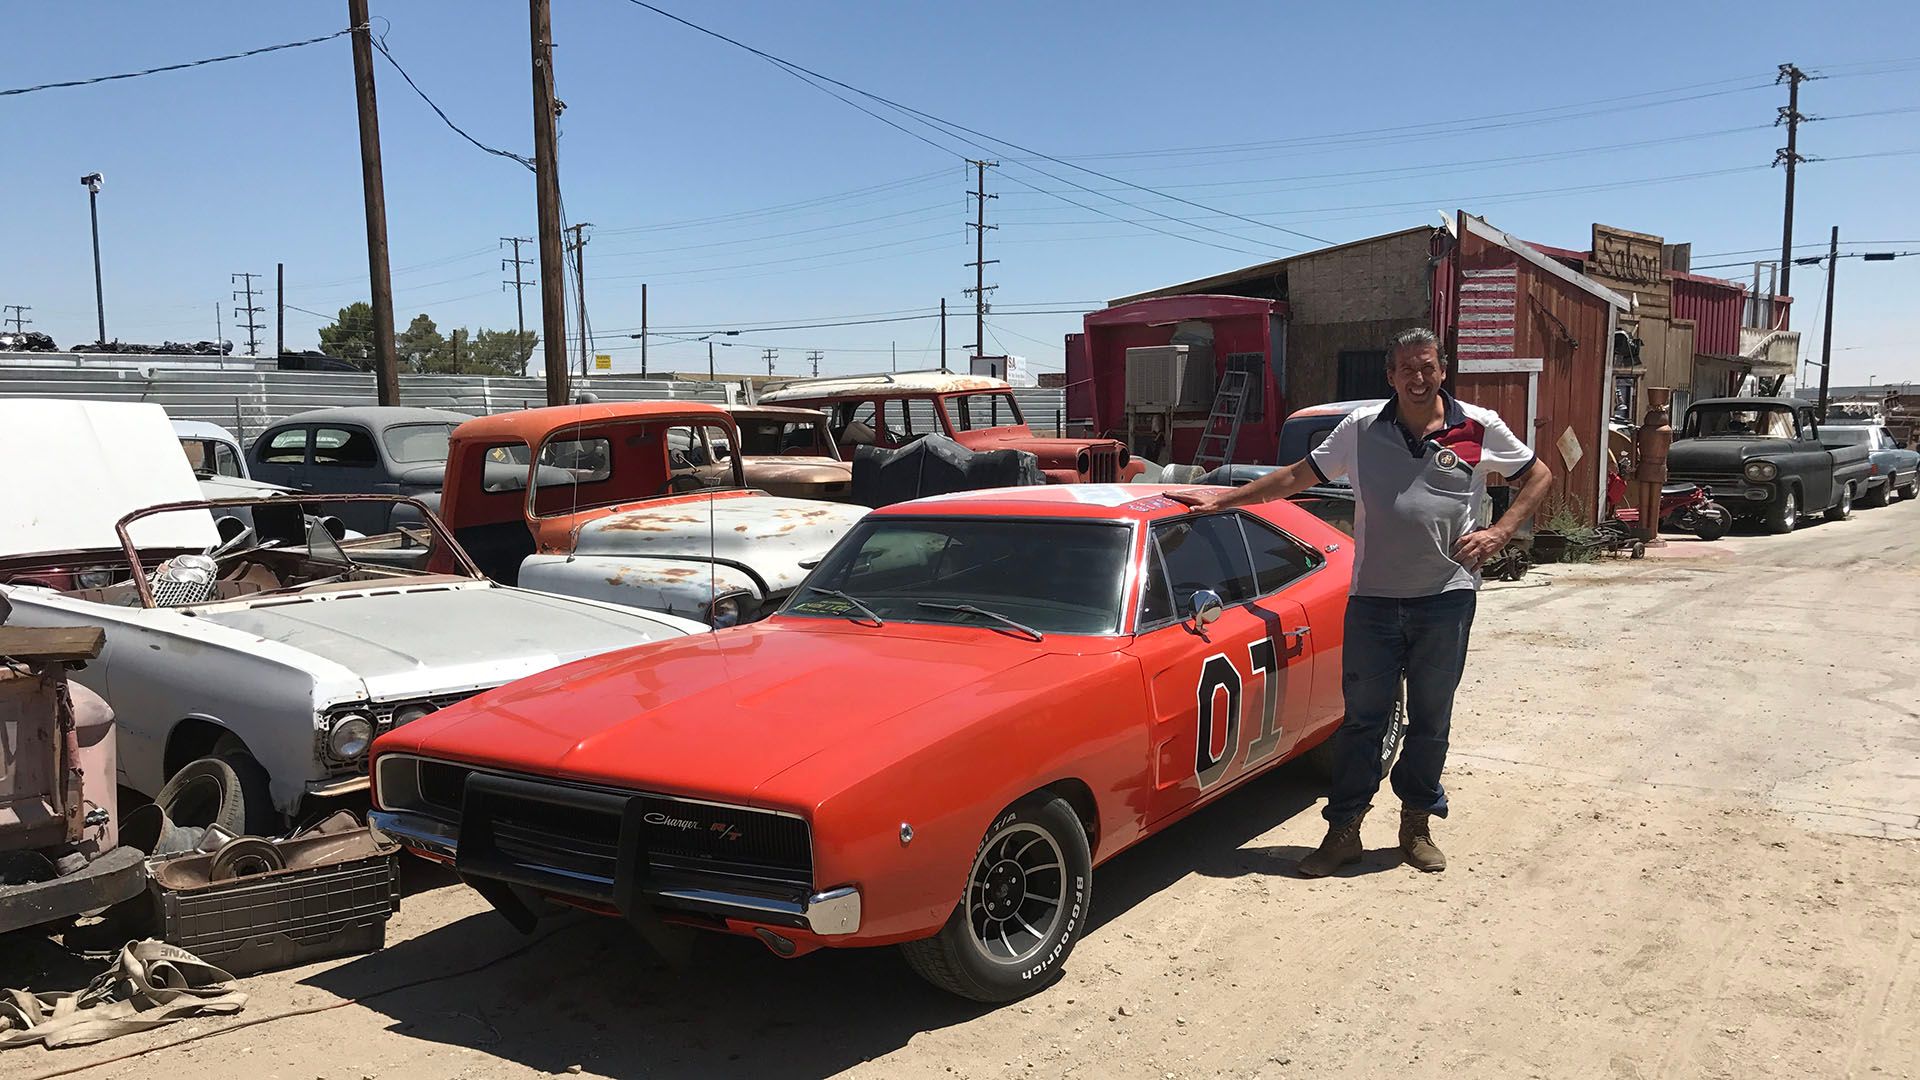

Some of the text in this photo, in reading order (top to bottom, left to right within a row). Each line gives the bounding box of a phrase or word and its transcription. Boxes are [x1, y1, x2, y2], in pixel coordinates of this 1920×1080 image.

[1599, 235, 1659, 287] Saloon
[1194, 636, 1283, 790] 01
[1389, 701, 1400, 748] Radial
[644, 812, 742, 841] Charger R/T
[994, 812, 1016, 831] T/A
[1022, 876, 1084, 980] BFGoodrich
